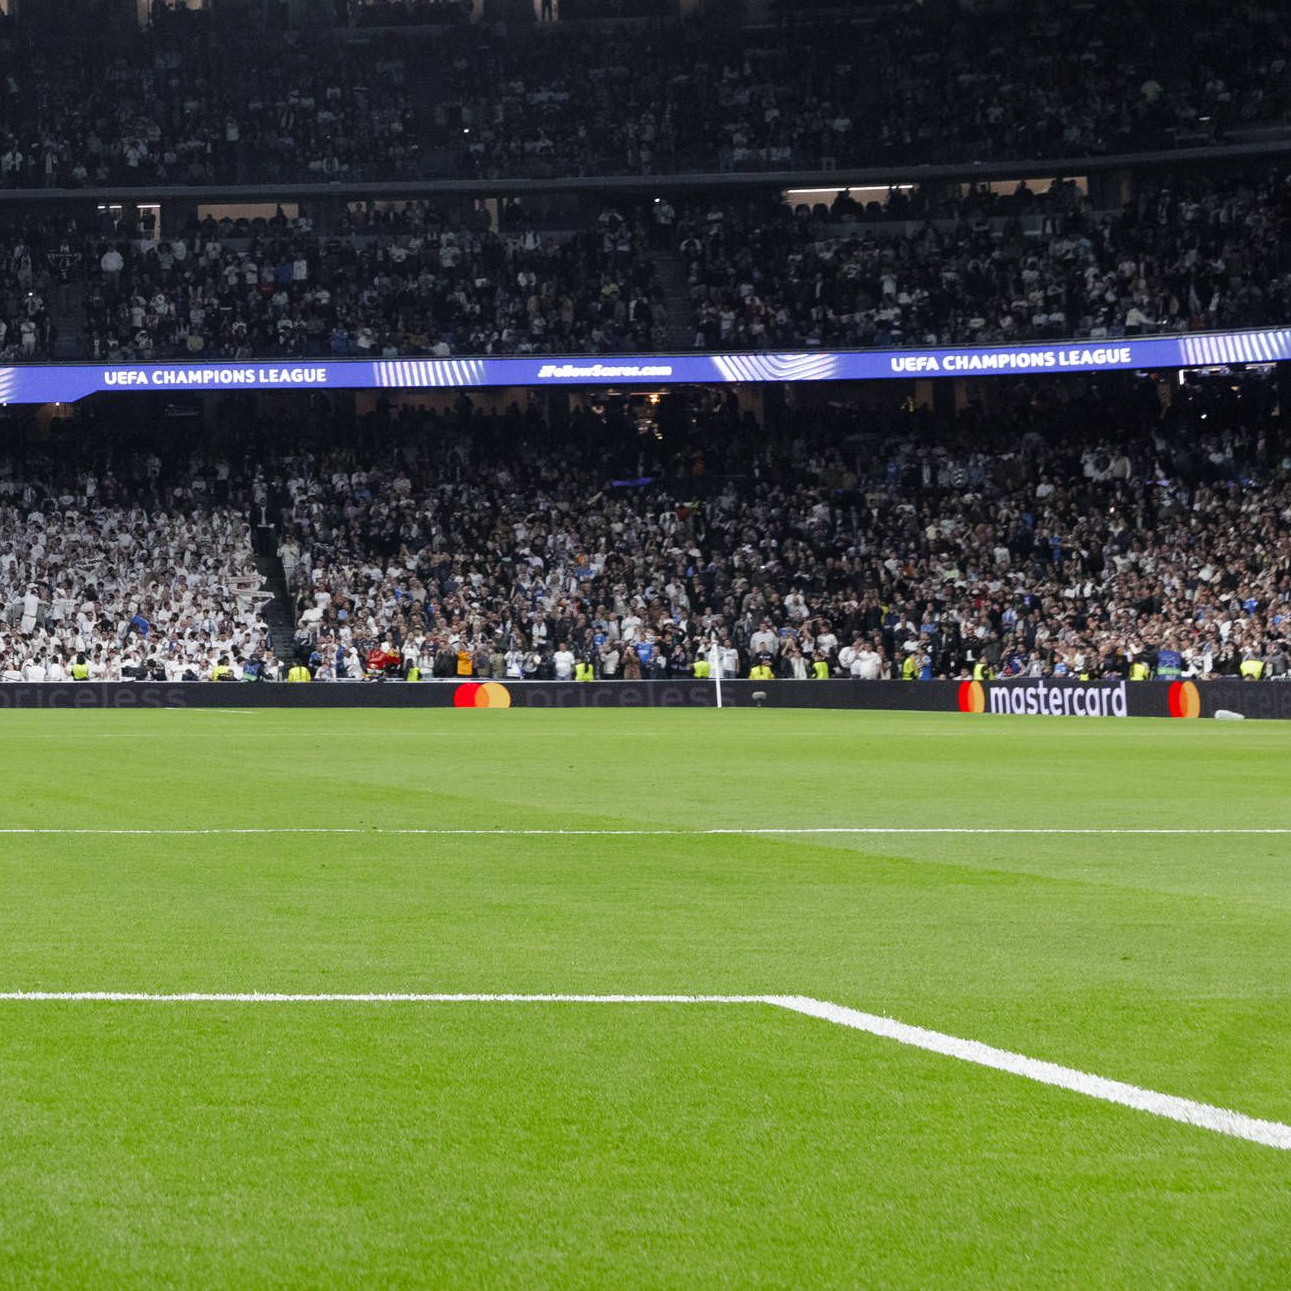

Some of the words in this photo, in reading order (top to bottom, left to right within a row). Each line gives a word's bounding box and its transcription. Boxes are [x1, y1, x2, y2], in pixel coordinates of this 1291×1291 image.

[891, 356, 939, 373] UEFA
[942, 351, 1056, 371] CHAMPIONS
[1059, 346, 1132, 366] LEAGUE
[104, 369, 149, 386] UEFA
[151, 368, 256, 385] CHAMPIONS
[259, 366, 327, 383] LEAGUE
[989, 679, 1128, 717] mastercard
